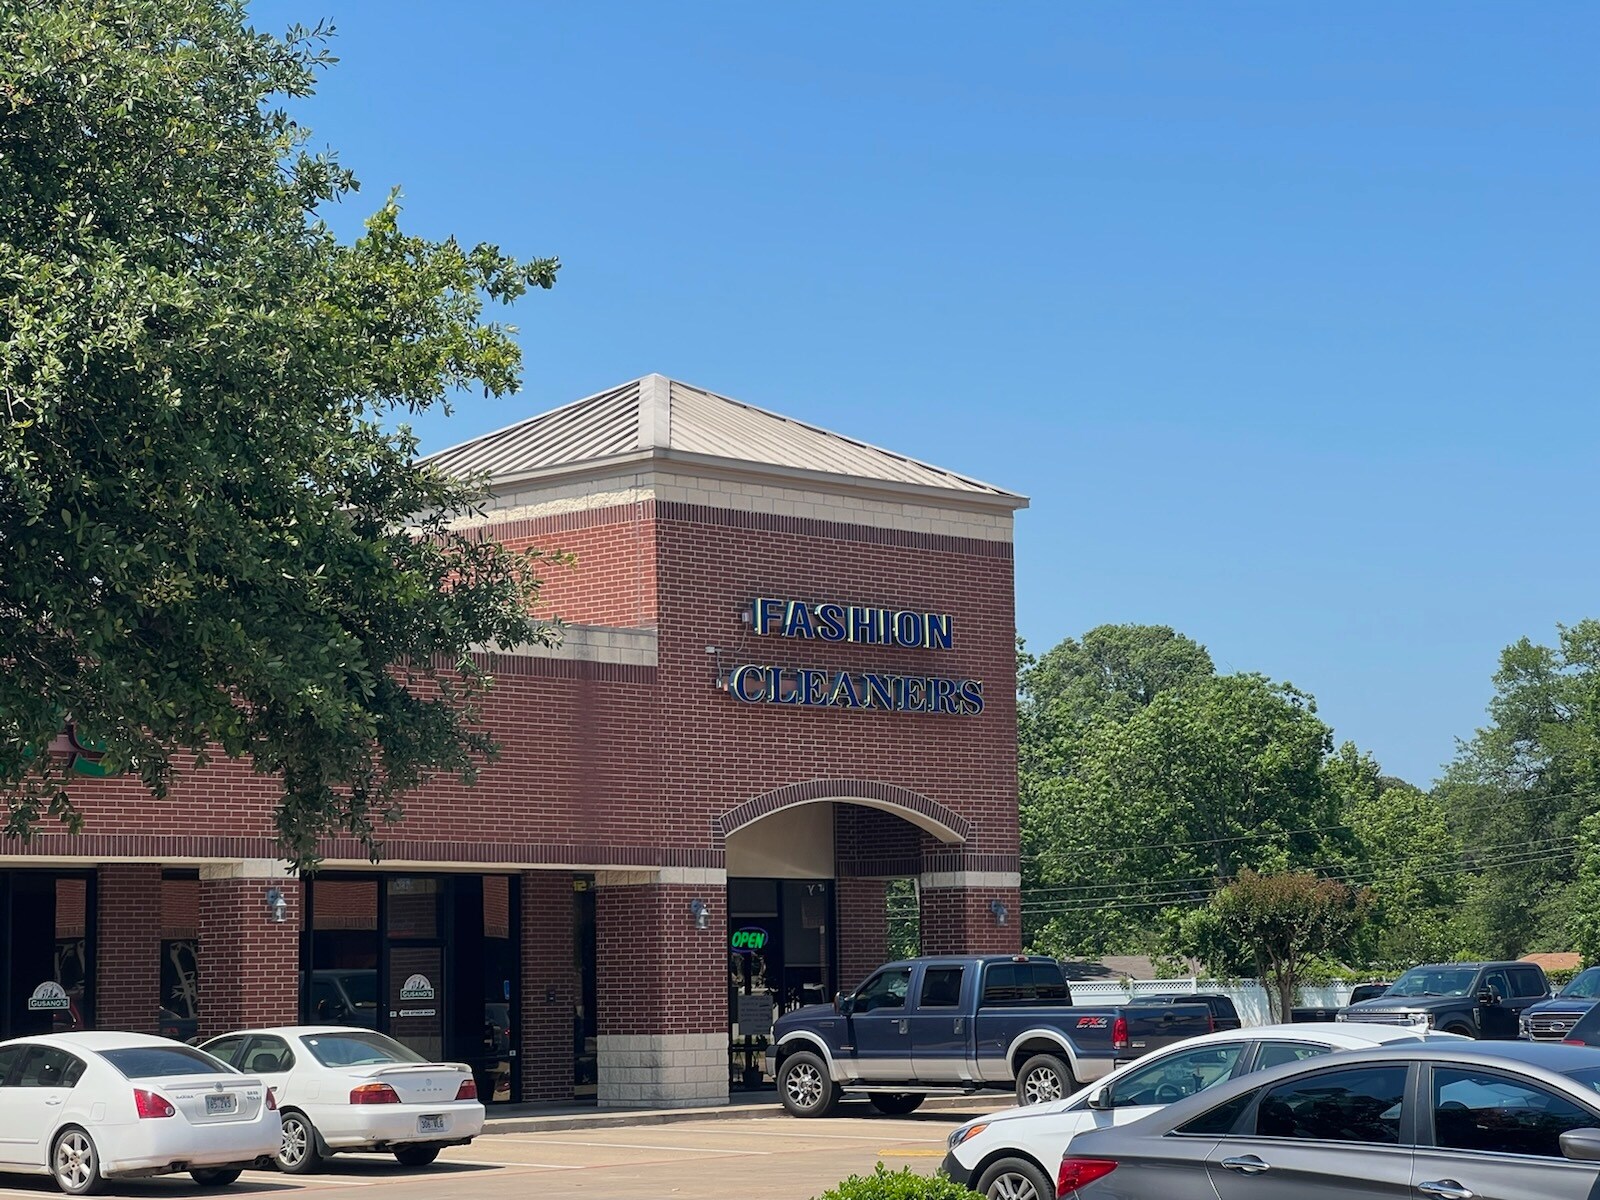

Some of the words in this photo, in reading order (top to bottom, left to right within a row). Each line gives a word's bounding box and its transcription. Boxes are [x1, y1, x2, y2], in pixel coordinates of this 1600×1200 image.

[753, 598, 953, 650] FASHION
[730, 664, 985, 715] CLEANERS
[731, 931, 765, 949] OPEN
[31, 999, 68, 1007] GUSANO'S
[1078, 1017, 1108, 1025] FX4
